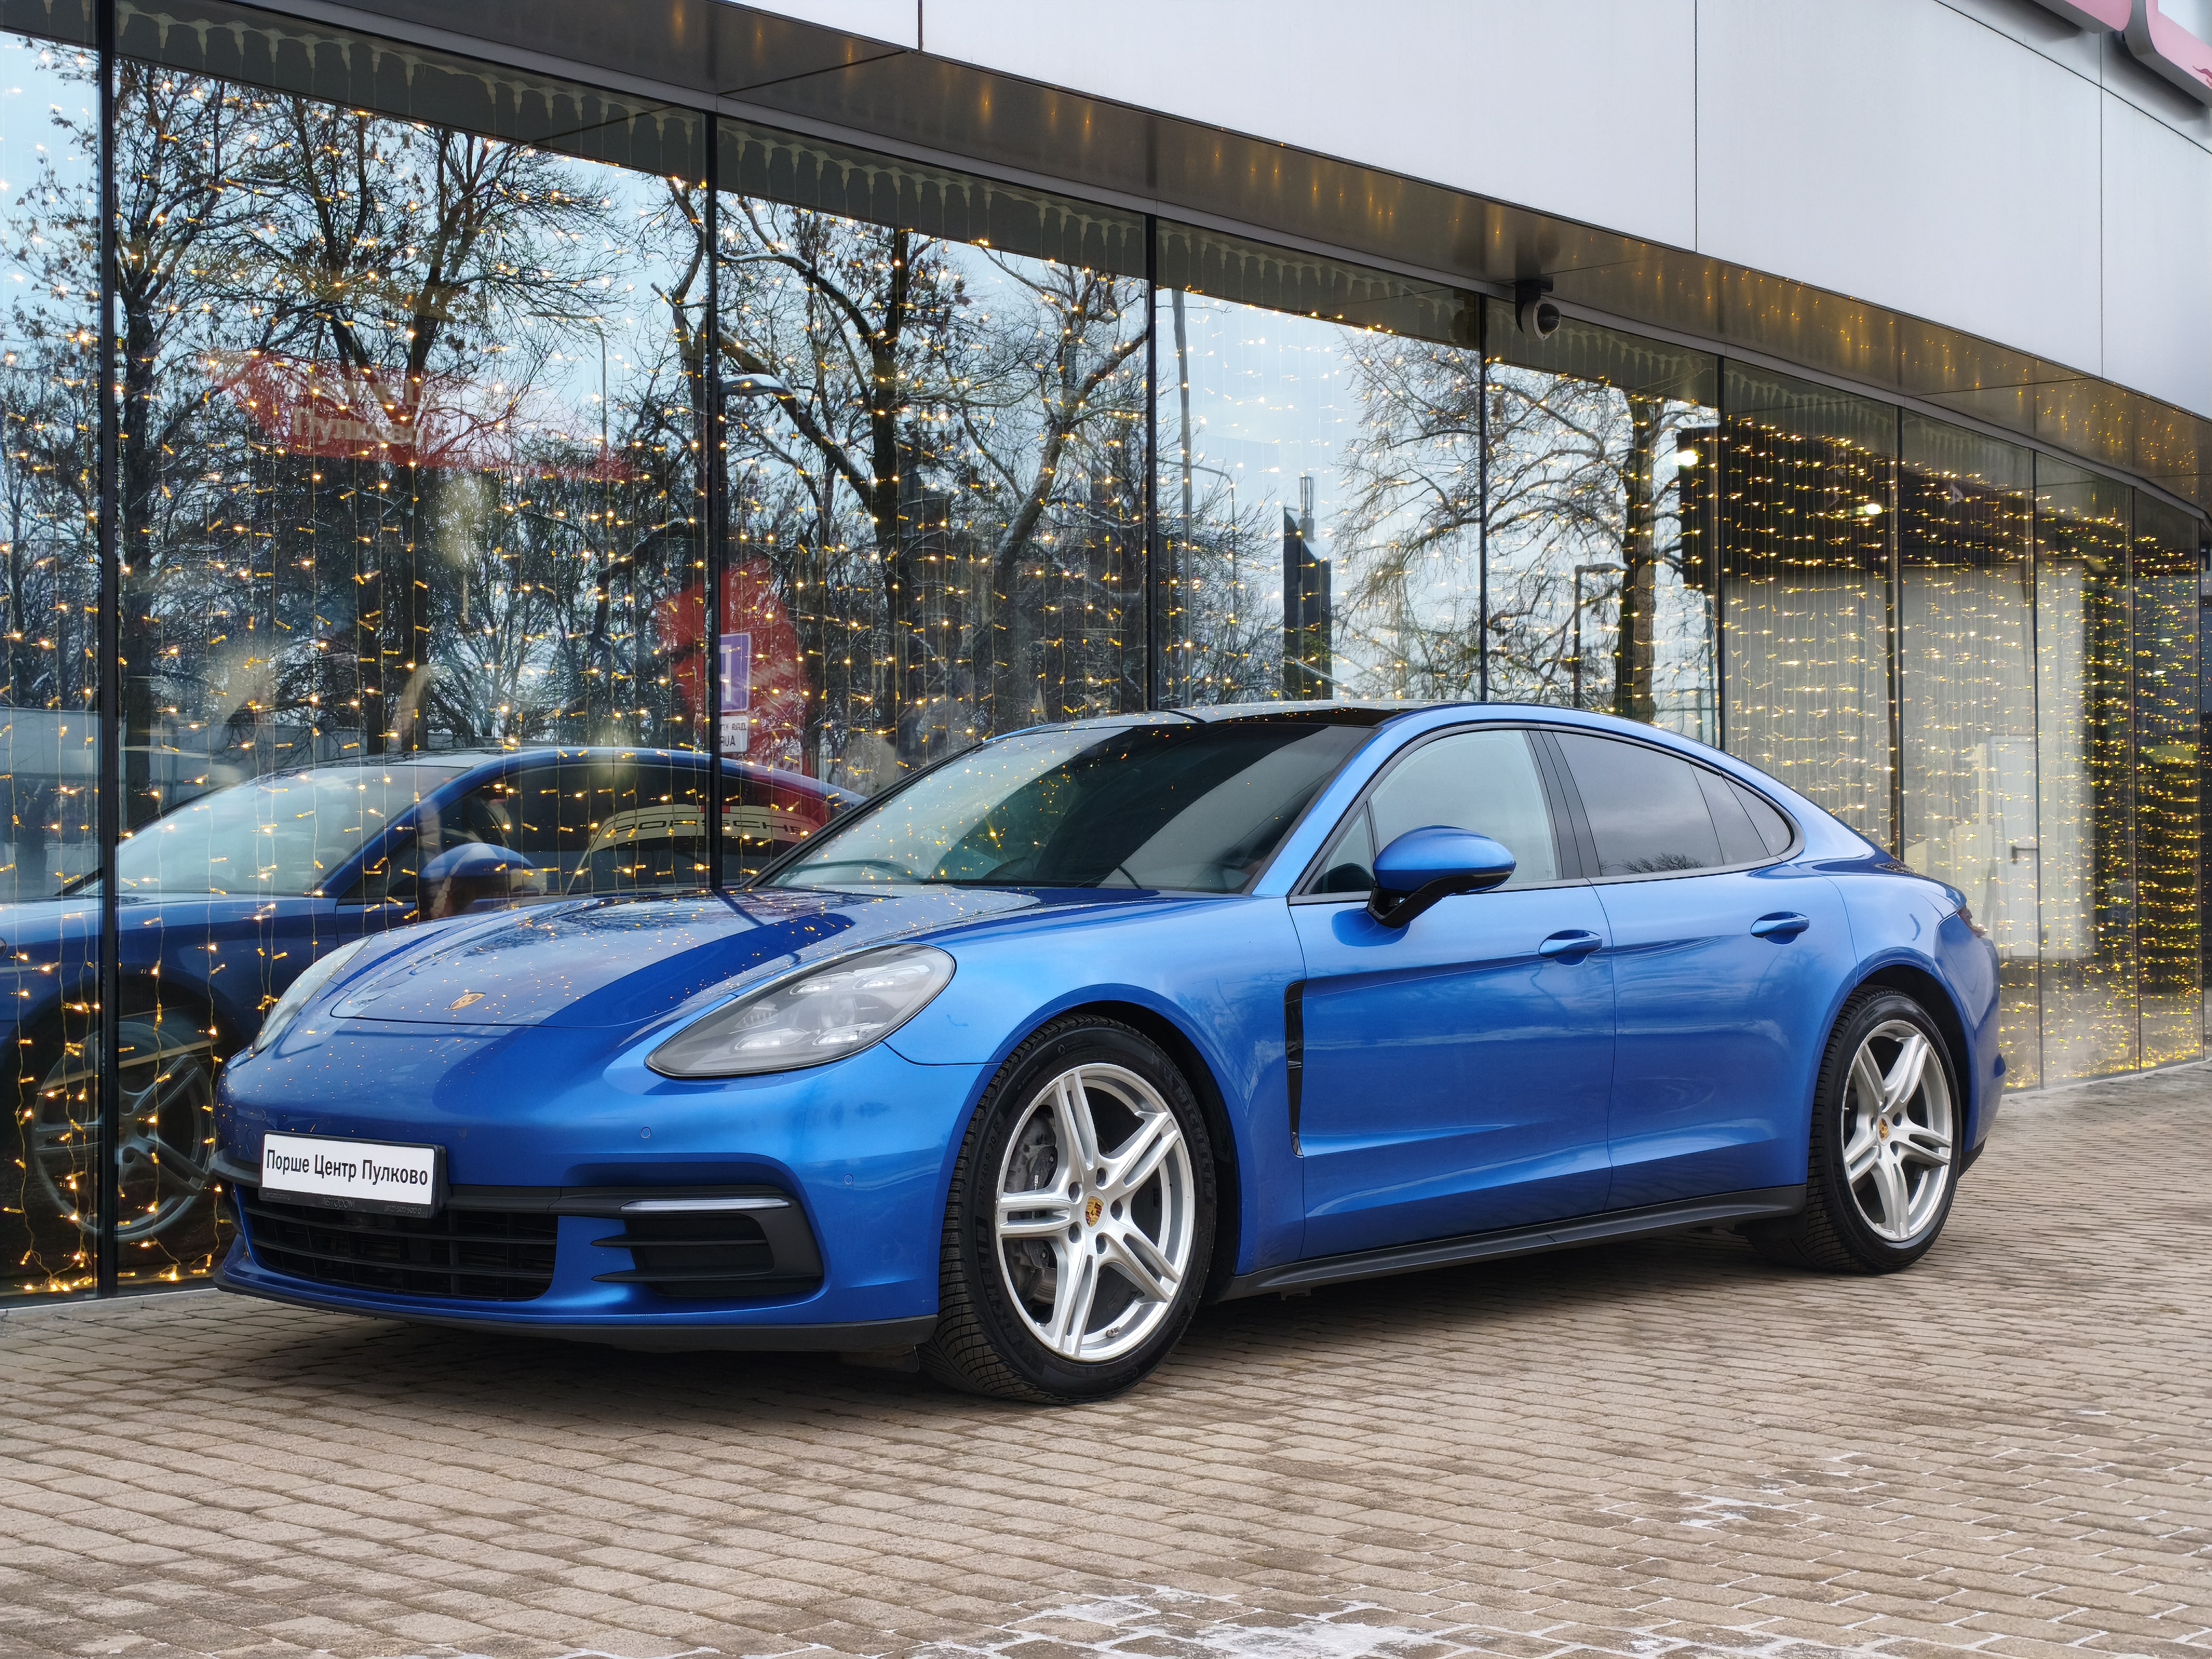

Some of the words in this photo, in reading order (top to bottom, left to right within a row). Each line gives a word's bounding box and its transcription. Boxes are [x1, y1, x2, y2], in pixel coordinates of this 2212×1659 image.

[266, 1149, 309, 1175] Порше
[314, 1154, 357, 1182] Центр
[361, 1159, 428, 1185] Пулково
